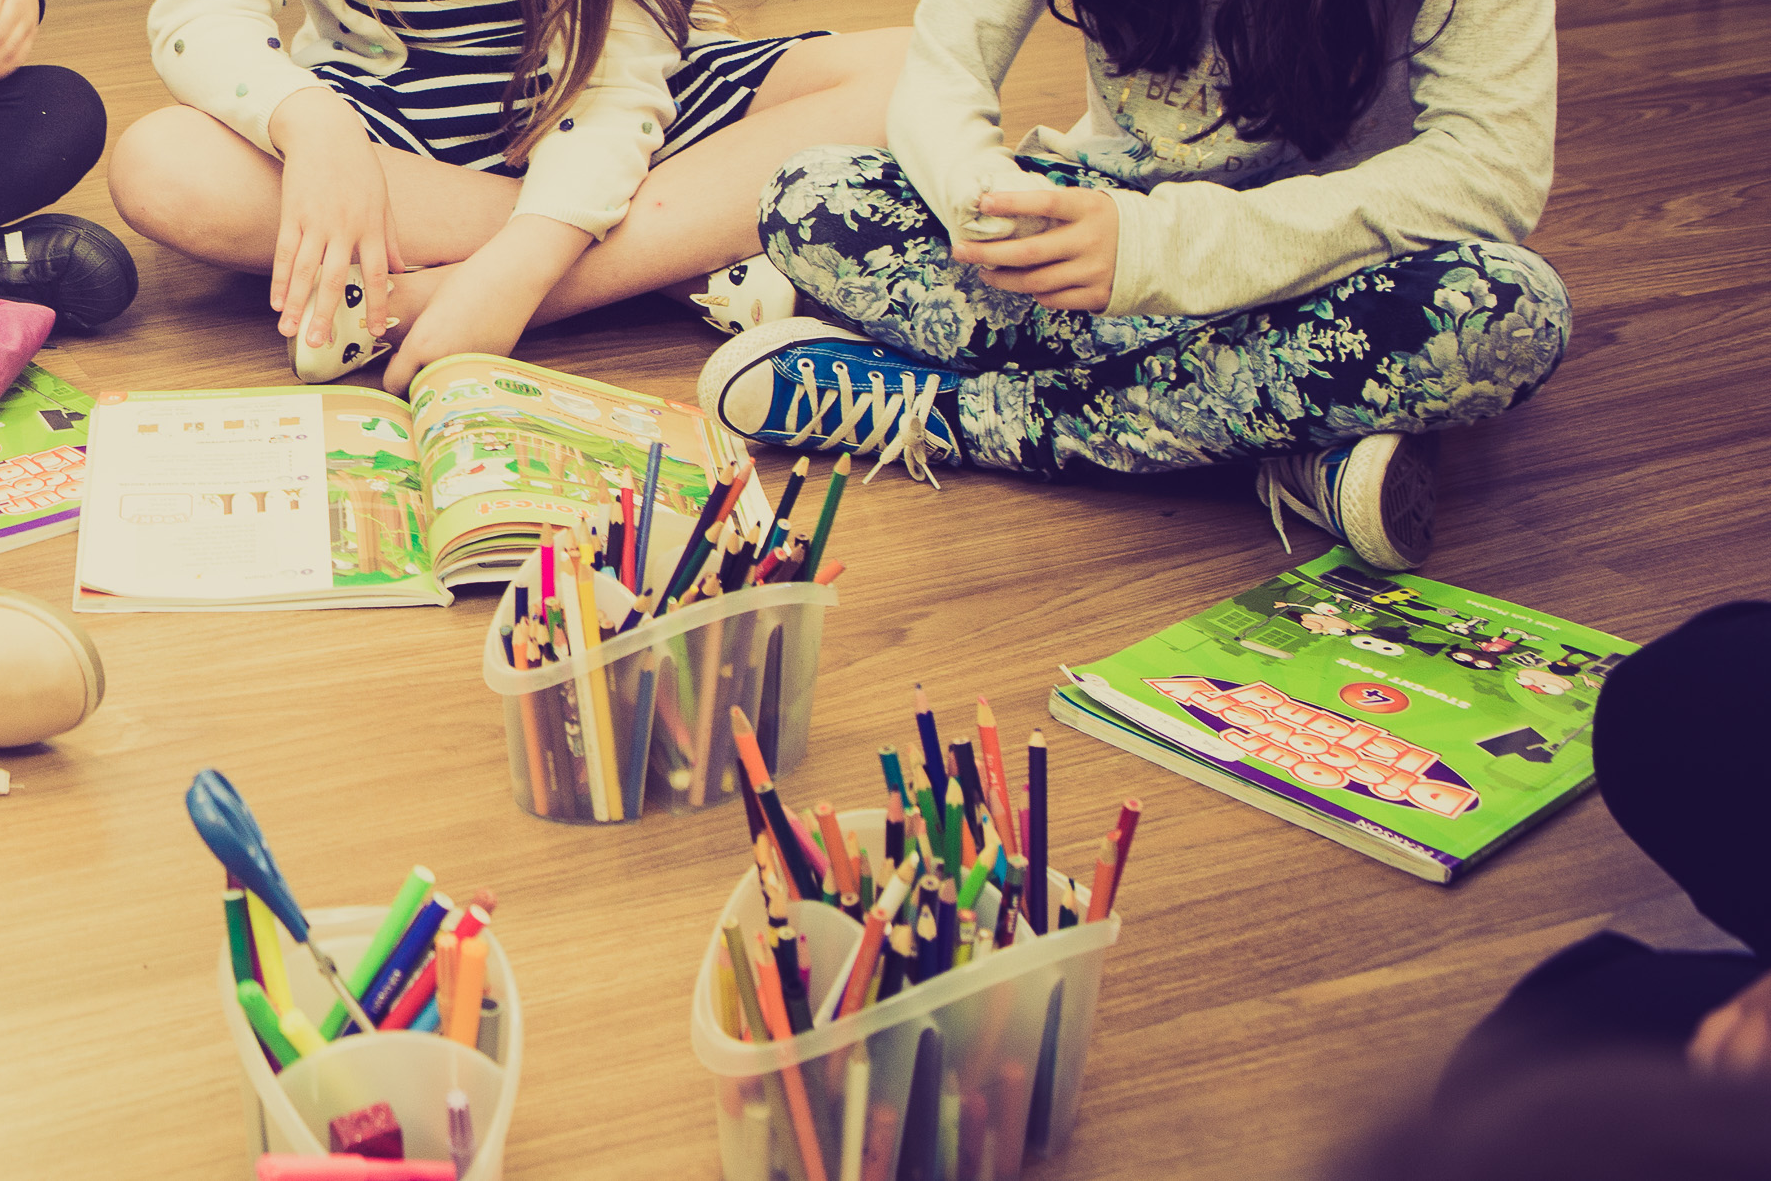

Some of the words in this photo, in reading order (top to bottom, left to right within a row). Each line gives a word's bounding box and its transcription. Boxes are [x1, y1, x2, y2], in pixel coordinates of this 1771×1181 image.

[476, 499, 592, 519] forest
[1335, 657, 1387, 679] BOOK
[1355, 686, 1396, 707] 4
[1387, 675, 1472, 710] STUDENT
[1238, 681, 1441, 776] Island
[1142, 676, 1480, 820] Discovery
[1221, 728, 1348, 787] Our
